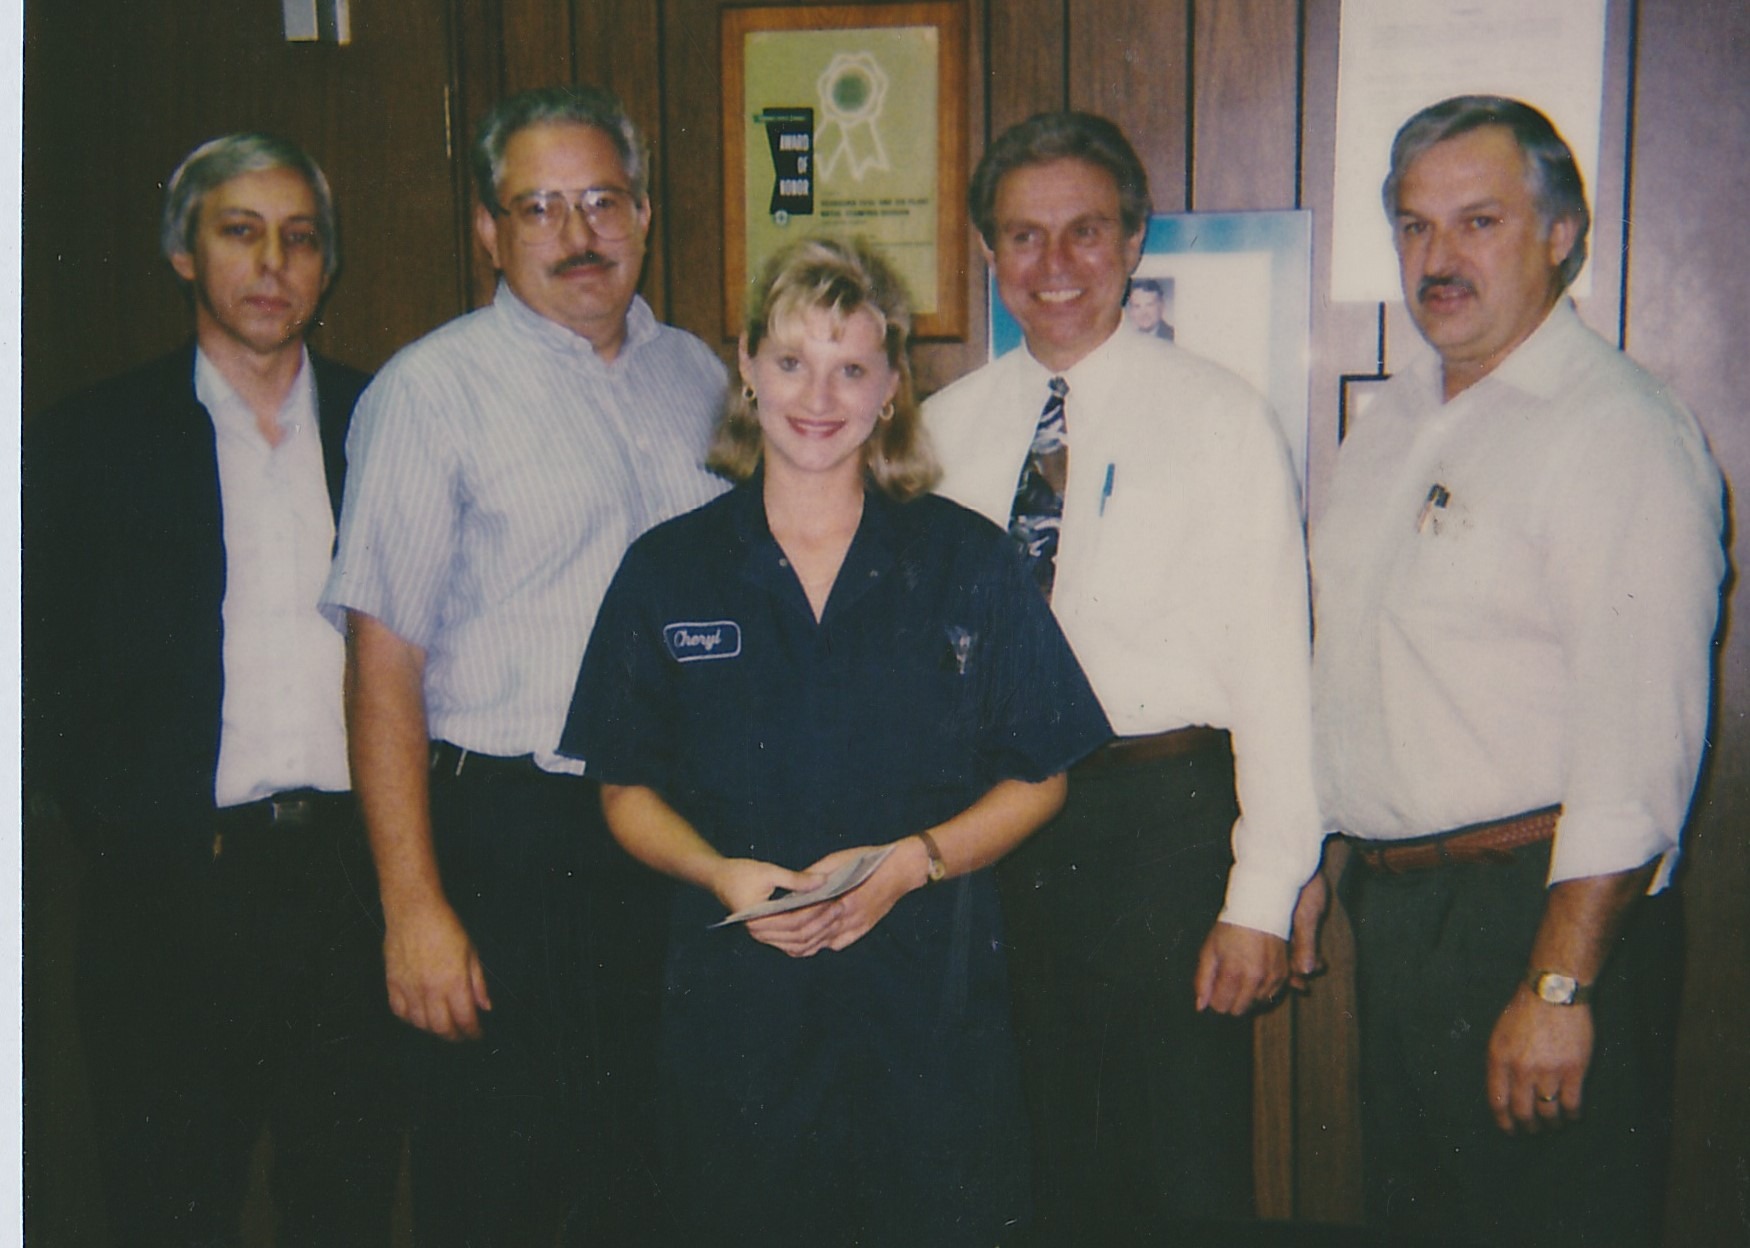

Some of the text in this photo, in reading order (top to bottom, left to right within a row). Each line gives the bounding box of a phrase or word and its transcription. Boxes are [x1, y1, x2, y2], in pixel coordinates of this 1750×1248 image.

[780, 133, 809, 151] AWARD
[797, 156, 808, 174] OF
[780, 179, 809, 196] HONOR
[673, 628, 721, 651] Cheryl
